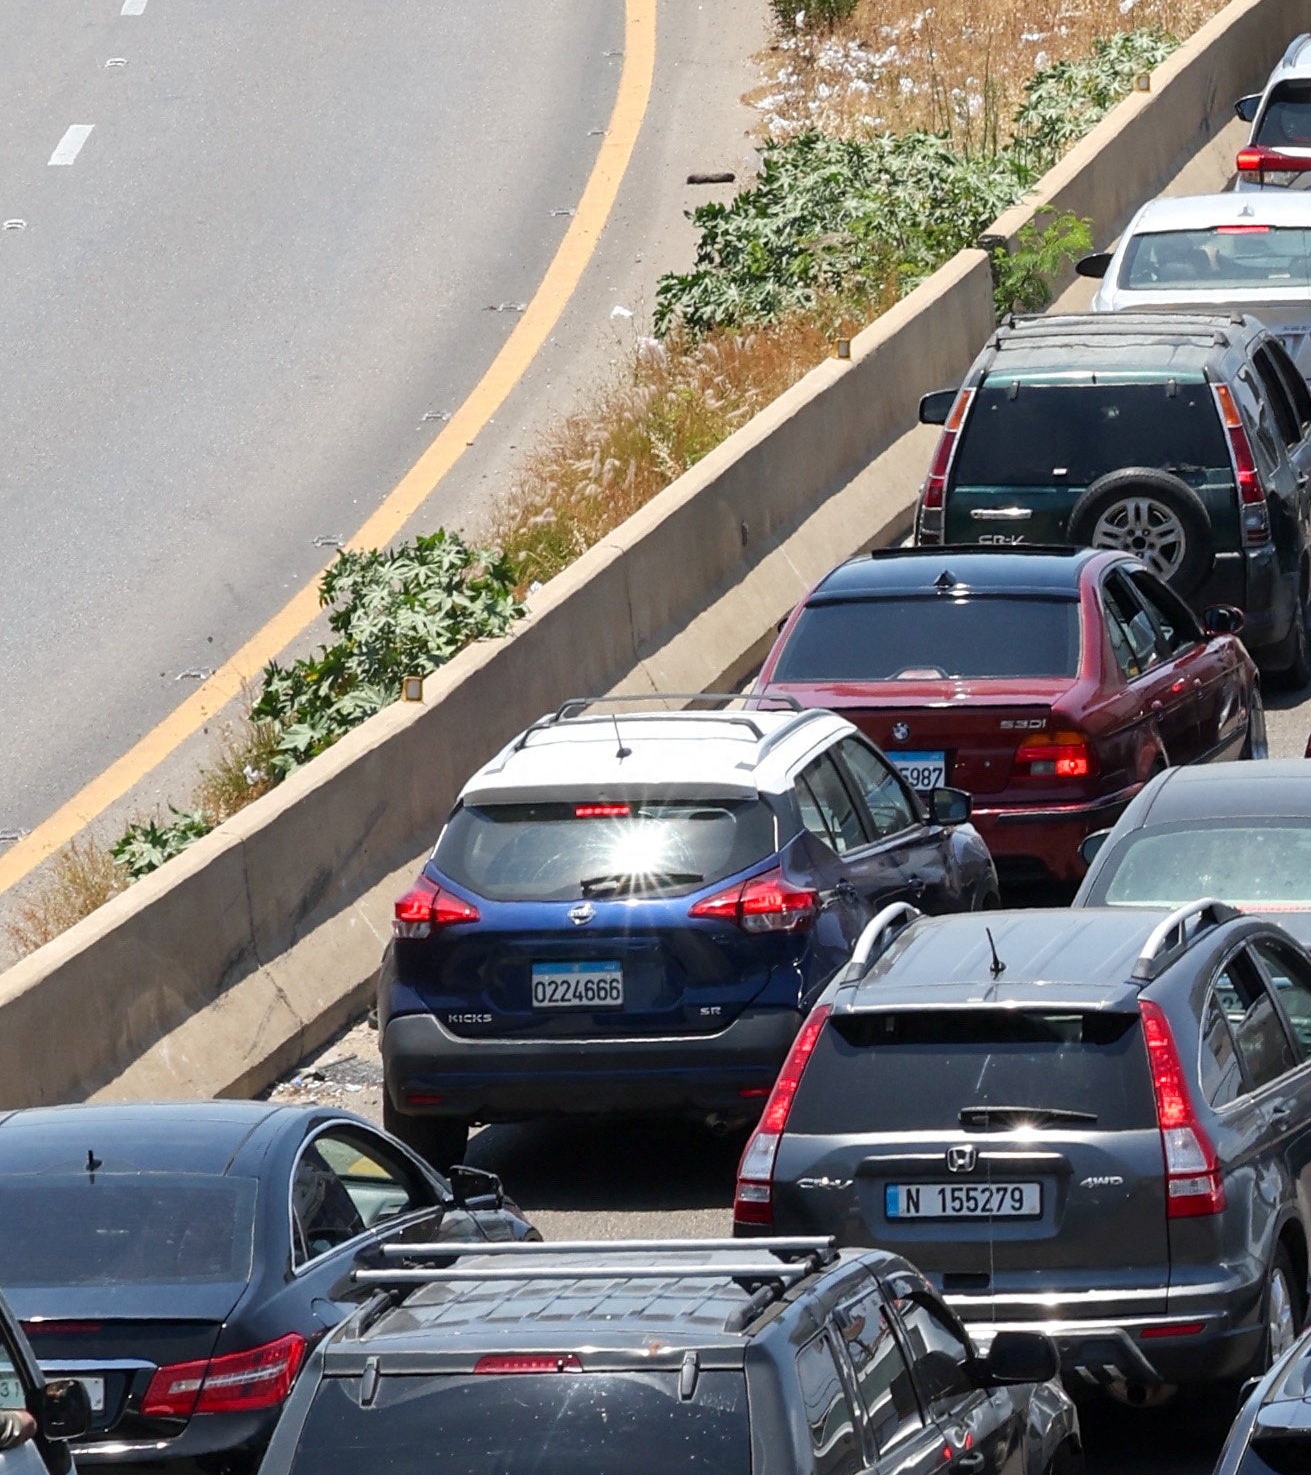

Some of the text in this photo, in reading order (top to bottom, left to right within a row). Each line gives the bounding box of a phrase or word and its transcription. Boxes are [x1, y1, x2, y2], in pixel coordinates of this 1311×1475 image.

[700, 1006, 722, 1016] SR
[448, 1014, 493, 1023] KICKS
[906, 1186, 1026, 1215] N 155279
